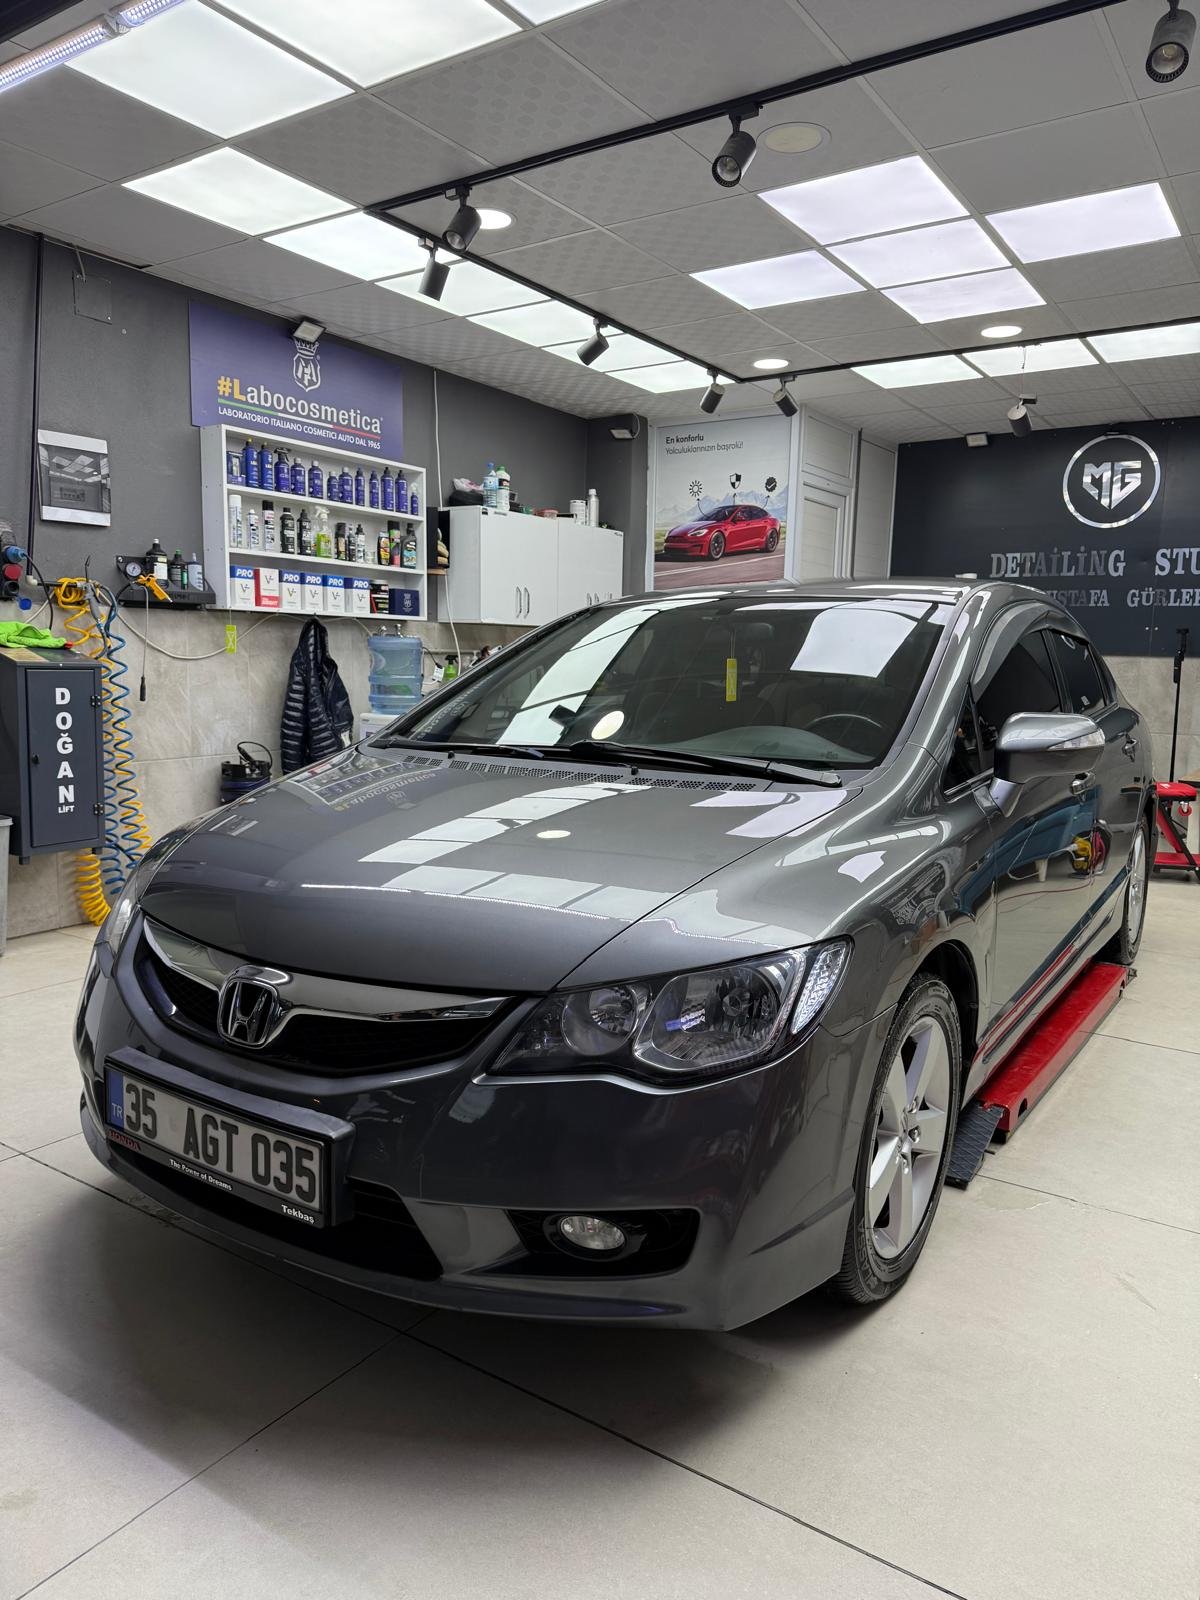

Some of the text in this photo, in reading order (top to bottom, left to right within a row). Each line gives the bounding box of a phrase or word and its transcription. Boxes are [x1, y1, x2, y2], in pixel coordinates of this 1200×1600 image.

[217, 375, 381, 433] #Labocosmetica
[218, 406, 381, 450] LABORATORIO ITALIANO COSMETICI AUTO DAL 1965
[665, 433, 704, 444] En konforlu
[1082, 460, 1142, 510] MG
[236, 568, 254, 578] PRO
[283, 573, 300, 582] PRO
[305, 575, 322, 584] PRO
[328, 578, 344, 586] PRO
[353, 580, 369, 588] PRO
[55, 687, 75, 804] DOĞAN
[58, 804, 75, 814] LİFT
[108, 1130, 142, 1151] HONDA
[111, 1082, 316, 1203] TR 35 AGT 035
[169, 1158, 181, 1169] The
[182, 1164, 200, 1177] Power
[208, 1175, 232, 1191] Dreams
